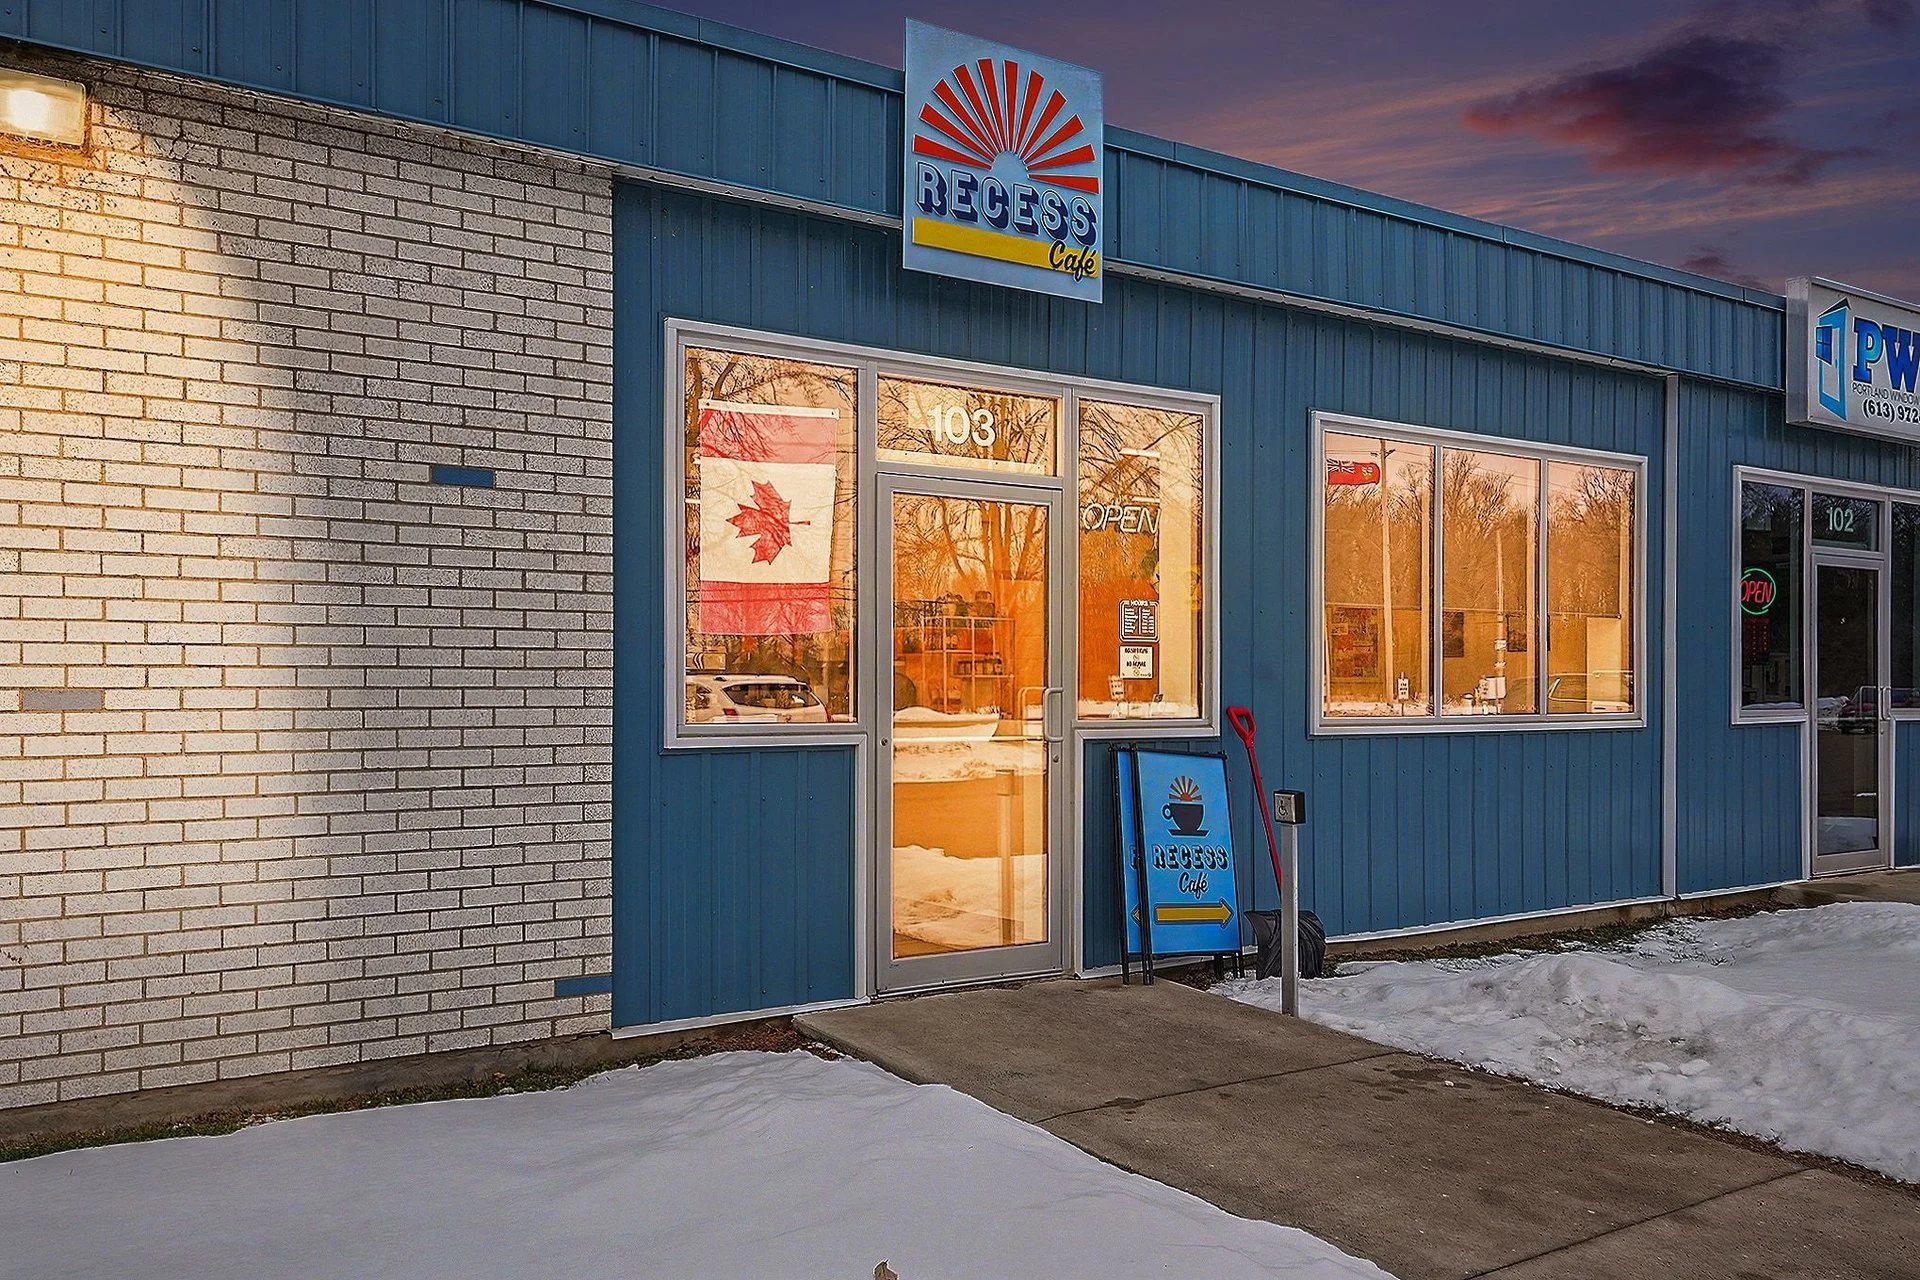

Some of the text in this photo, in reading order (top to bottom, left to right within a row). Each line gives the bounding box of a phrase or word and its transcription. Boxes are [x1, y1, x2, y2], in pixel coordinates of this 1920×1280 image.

[915, 161, 1099, 246] RECESS
[1049, 240, 1097, 282] Café
[1852, 382, 1889, 400] PORTLAND
[1863, 398, 1895, 423] (613)
[928, 404, 996, 446] 103
[1083, 503, 1161, 535] OPEN
[1826, 507, 1854, 532] 102
[1740, 580, 1772, 604] OPEN
[1152, 844, 1229, 870] RECESS
[1179, 871, 1209, 899] Café
